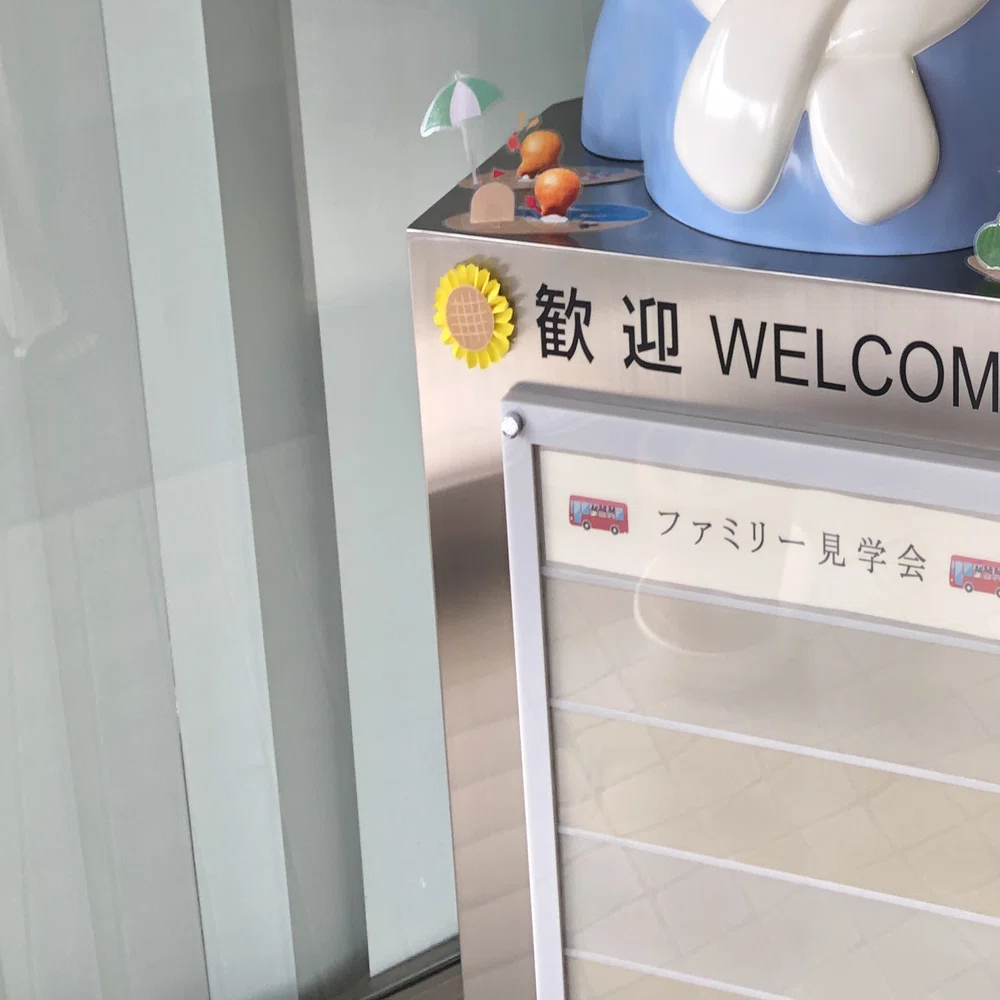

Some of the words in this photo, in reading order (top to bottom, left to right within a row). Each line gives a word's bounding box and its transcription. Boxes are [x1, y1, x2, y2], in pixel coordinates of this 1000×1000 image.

[658, 509, 927, 582] ファミリー見学会
